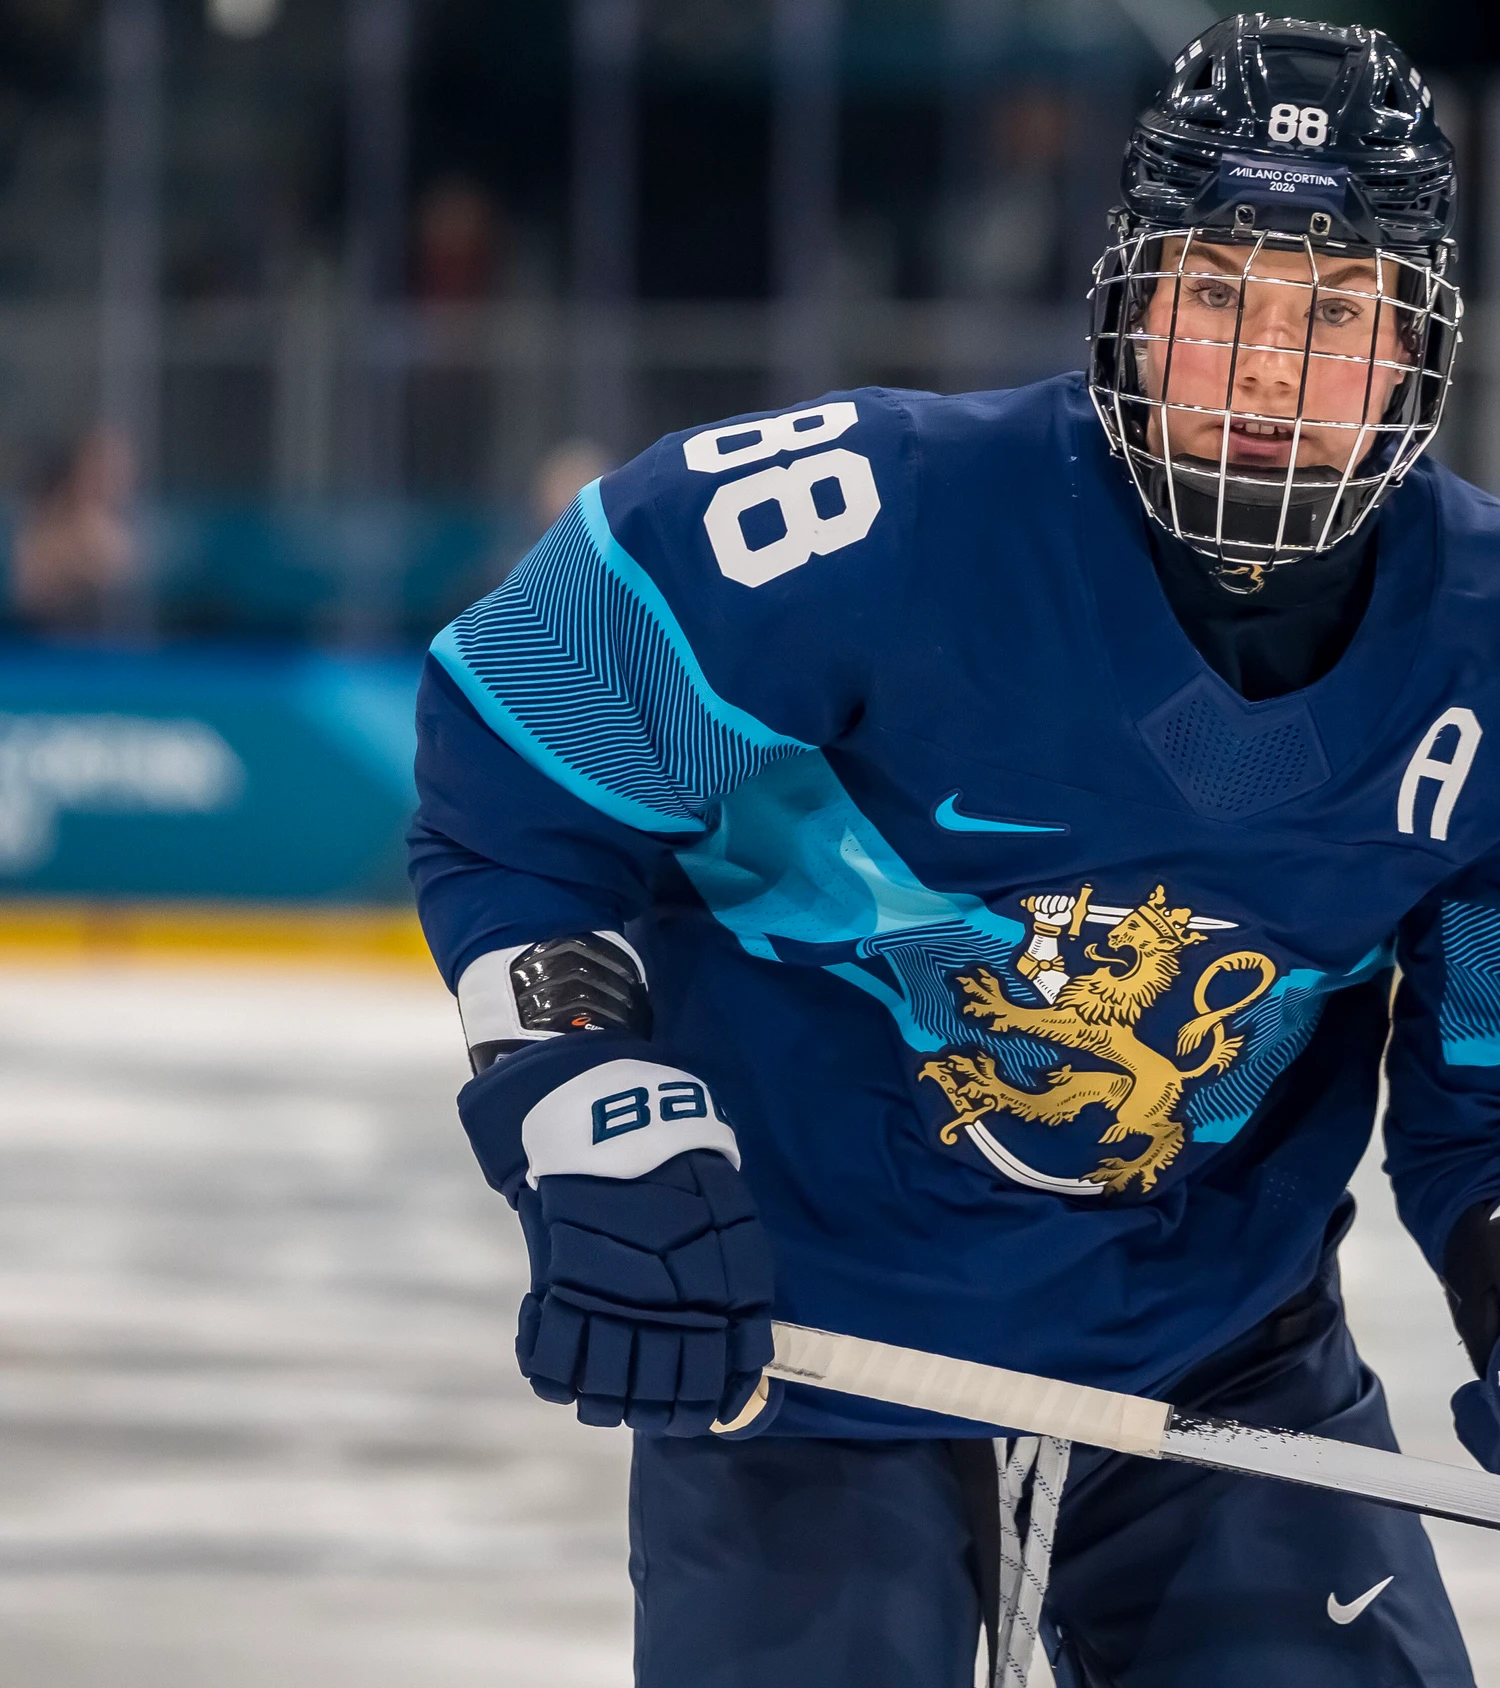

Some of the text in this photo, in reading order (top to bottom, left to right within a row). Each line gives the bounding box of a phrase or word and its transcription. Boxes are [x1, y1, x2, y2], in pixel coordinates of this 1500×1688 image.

[1267, 103, 1329, 147] 88
[1229, 166, 1338, 187] MILANO CORTINA
[1269, 181, 1296, 193] 2026
[682, 401, 882, 589] 88
[1397, 706, 1483, 841] A
[591, 1081, 735, 1146] Ba
